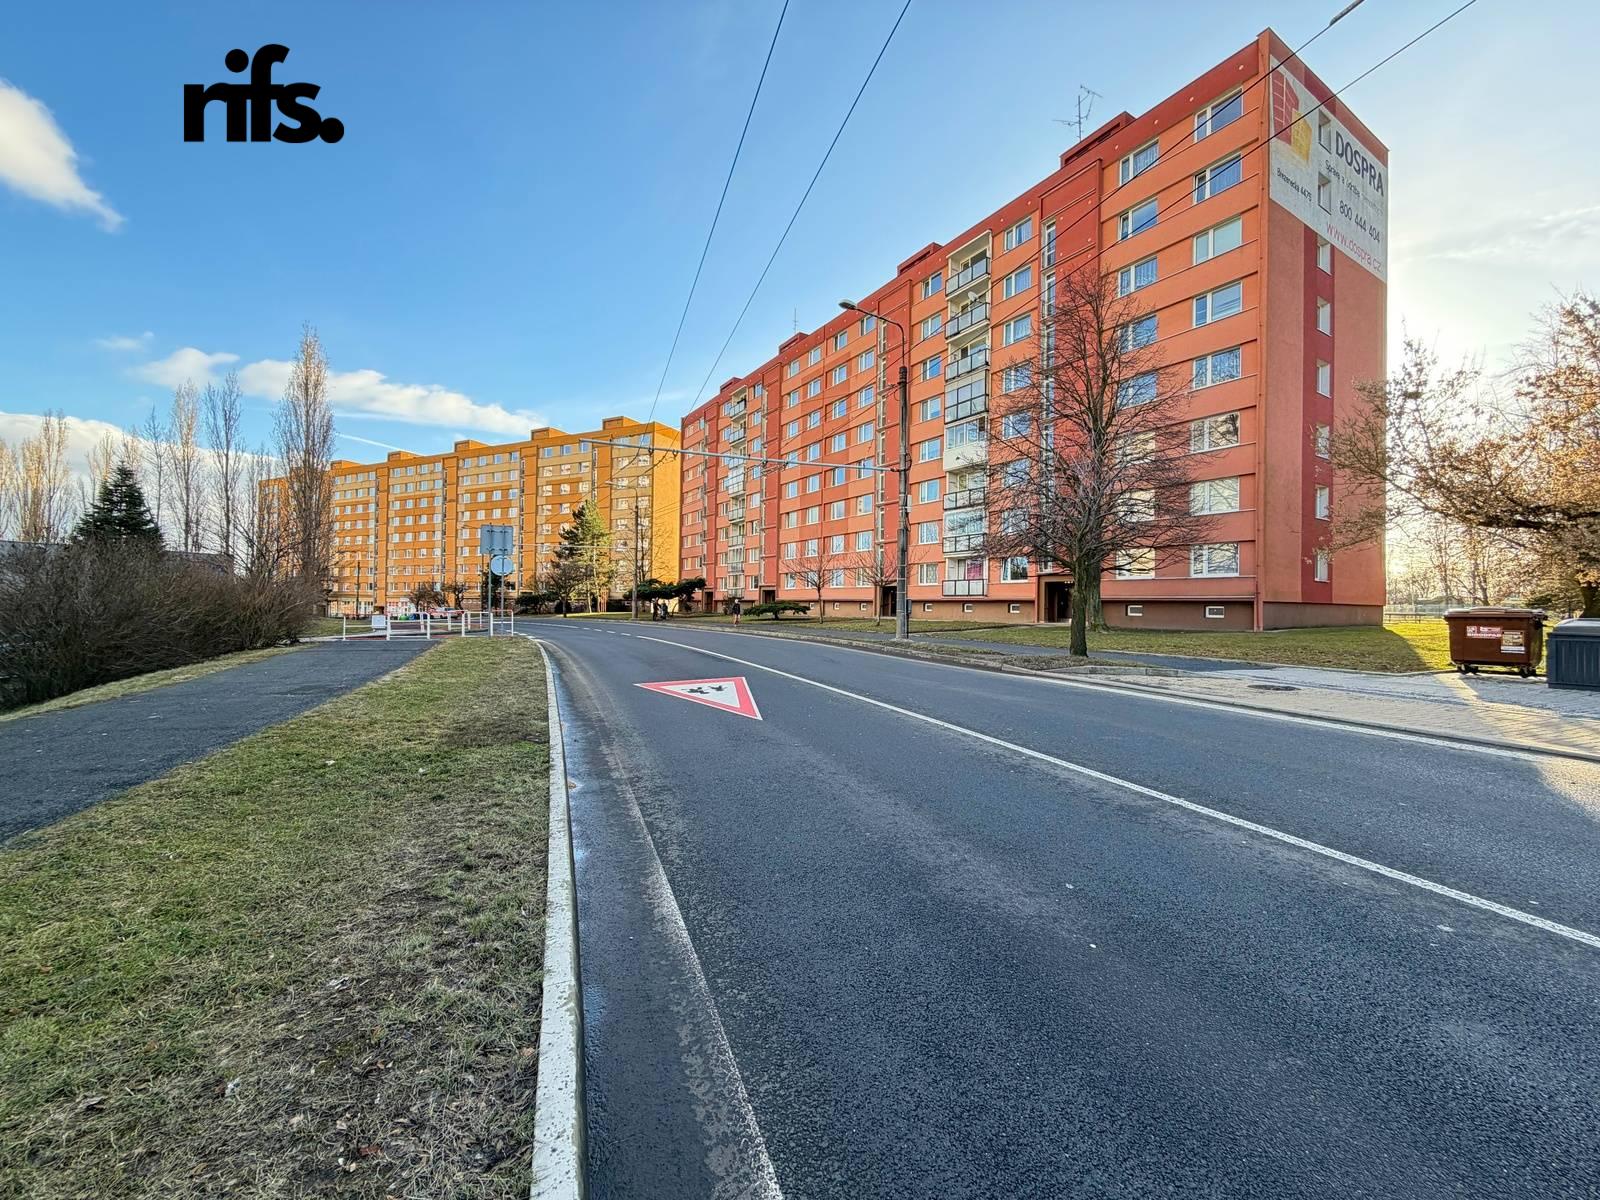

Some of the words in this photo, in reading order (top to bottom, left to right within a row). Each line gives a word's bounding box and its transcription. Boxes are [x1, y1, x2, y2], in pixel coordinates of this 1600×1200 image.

[1336, 130, 1384, 197] DOSPRA
[1326, 222, 1382, 273] www.dospra.cz
[1340, 200, 1353, 221] 800
[1354, 213, 1367, 232] 444
[1368, 225, 1380, 245] 404
